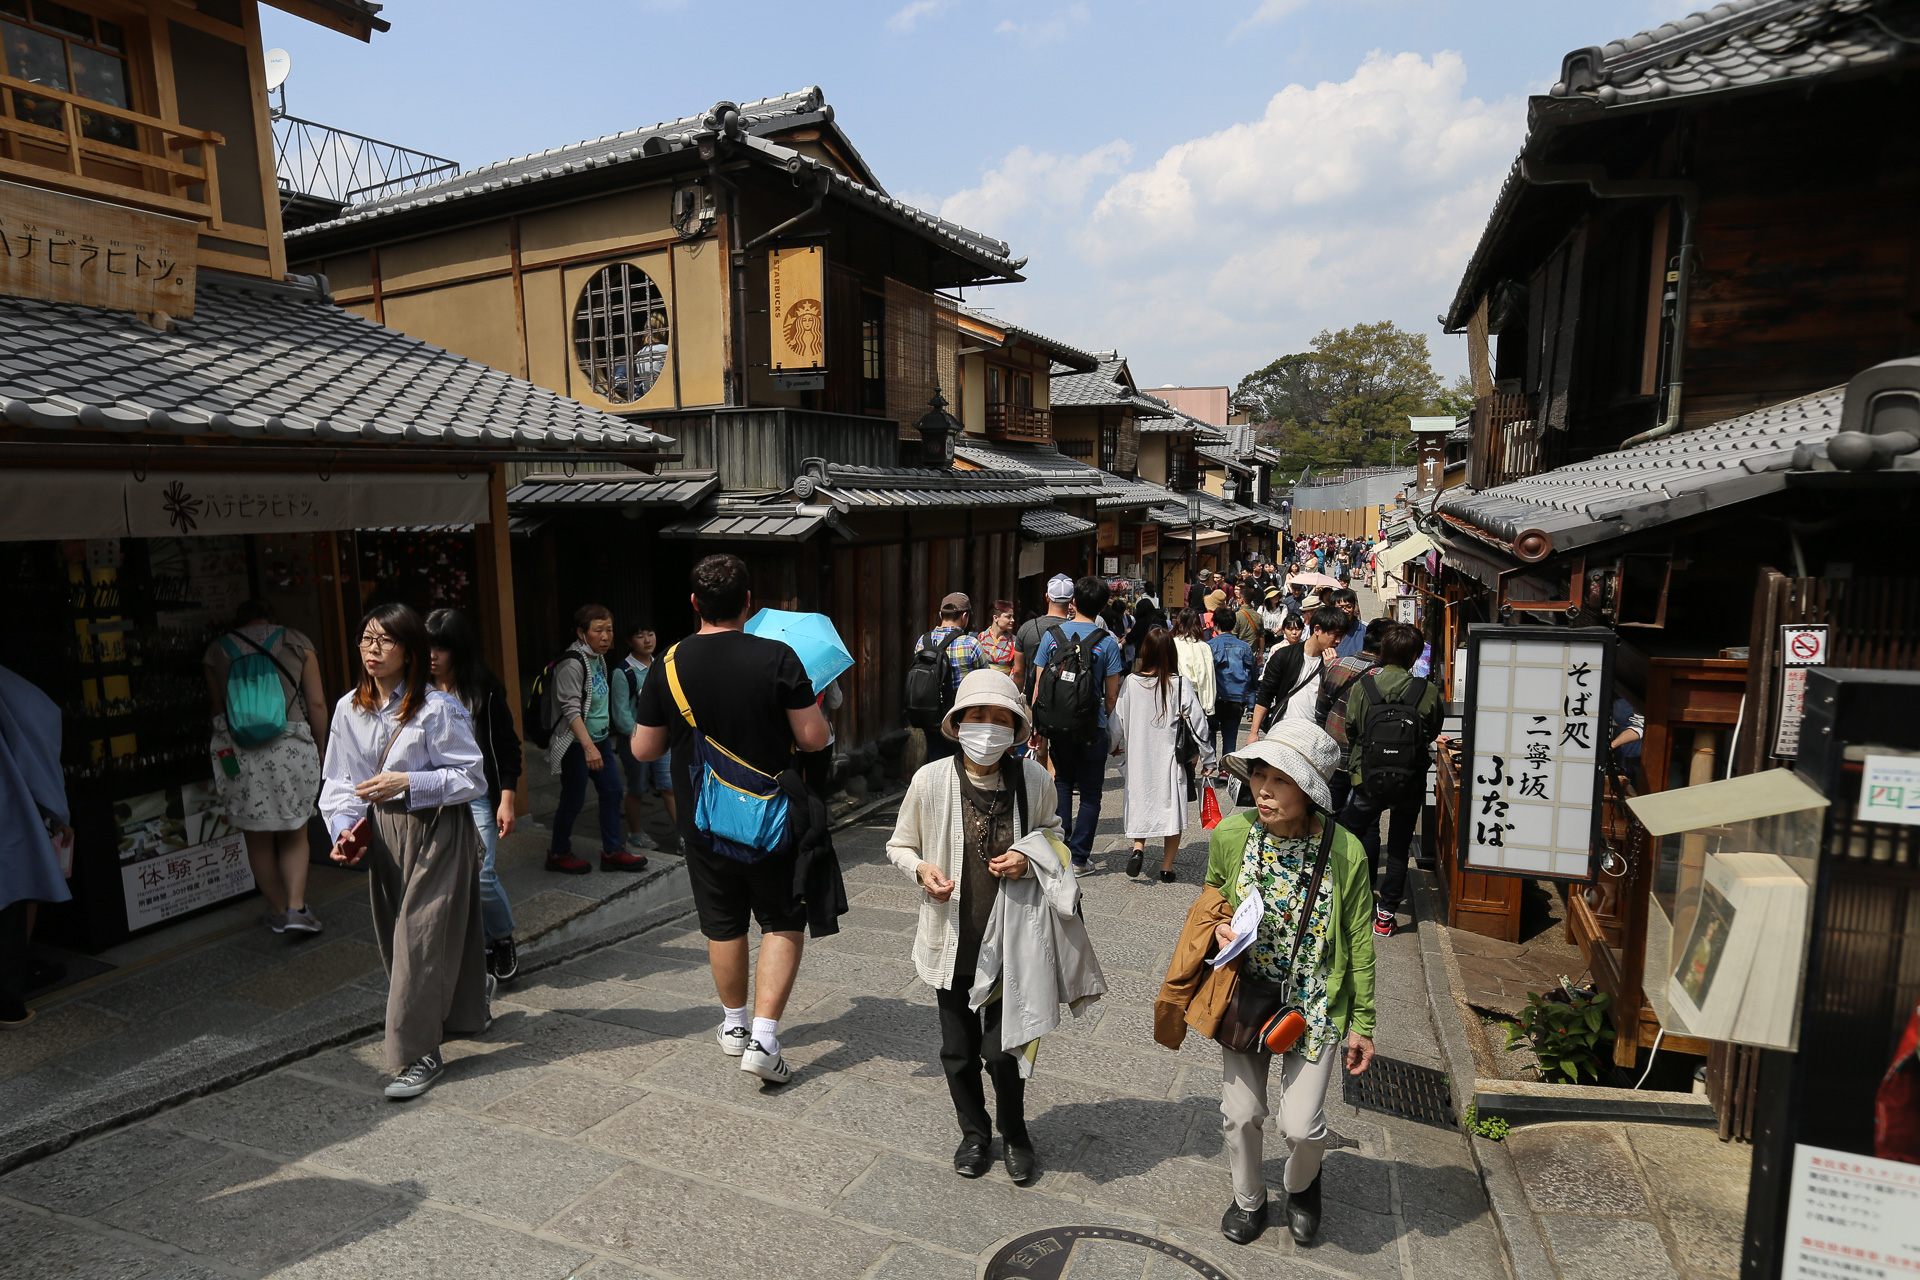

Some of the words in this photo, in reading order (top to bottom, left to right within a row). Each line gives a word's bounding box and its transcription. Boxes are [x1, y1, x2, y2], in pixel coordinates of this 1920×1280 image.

[23, 223, 38, 232] NA
[55, 229, 66, 237] BI
[82, 234, 95, 243] RA
[110, 239, 121, 247] HI
[135, 244, 146, 252] TO
[159, 248, 170, 256] TU
[773, 259, 781, 319] STARBUCKS
[1559, 661, 1591, 750] そば処
[1785, 672, 1798, 713] 禁止です
[1518, 716, 1551, 800] 二寧坂
[1476, 755, 1515, 848] ふたば
[137, 886, 166, 898] Handmade
[167, 876, 195, 889] experience
[138, 842, 243, 890] 体験工房
[1014, 1240, 1053, 1266] 合流
